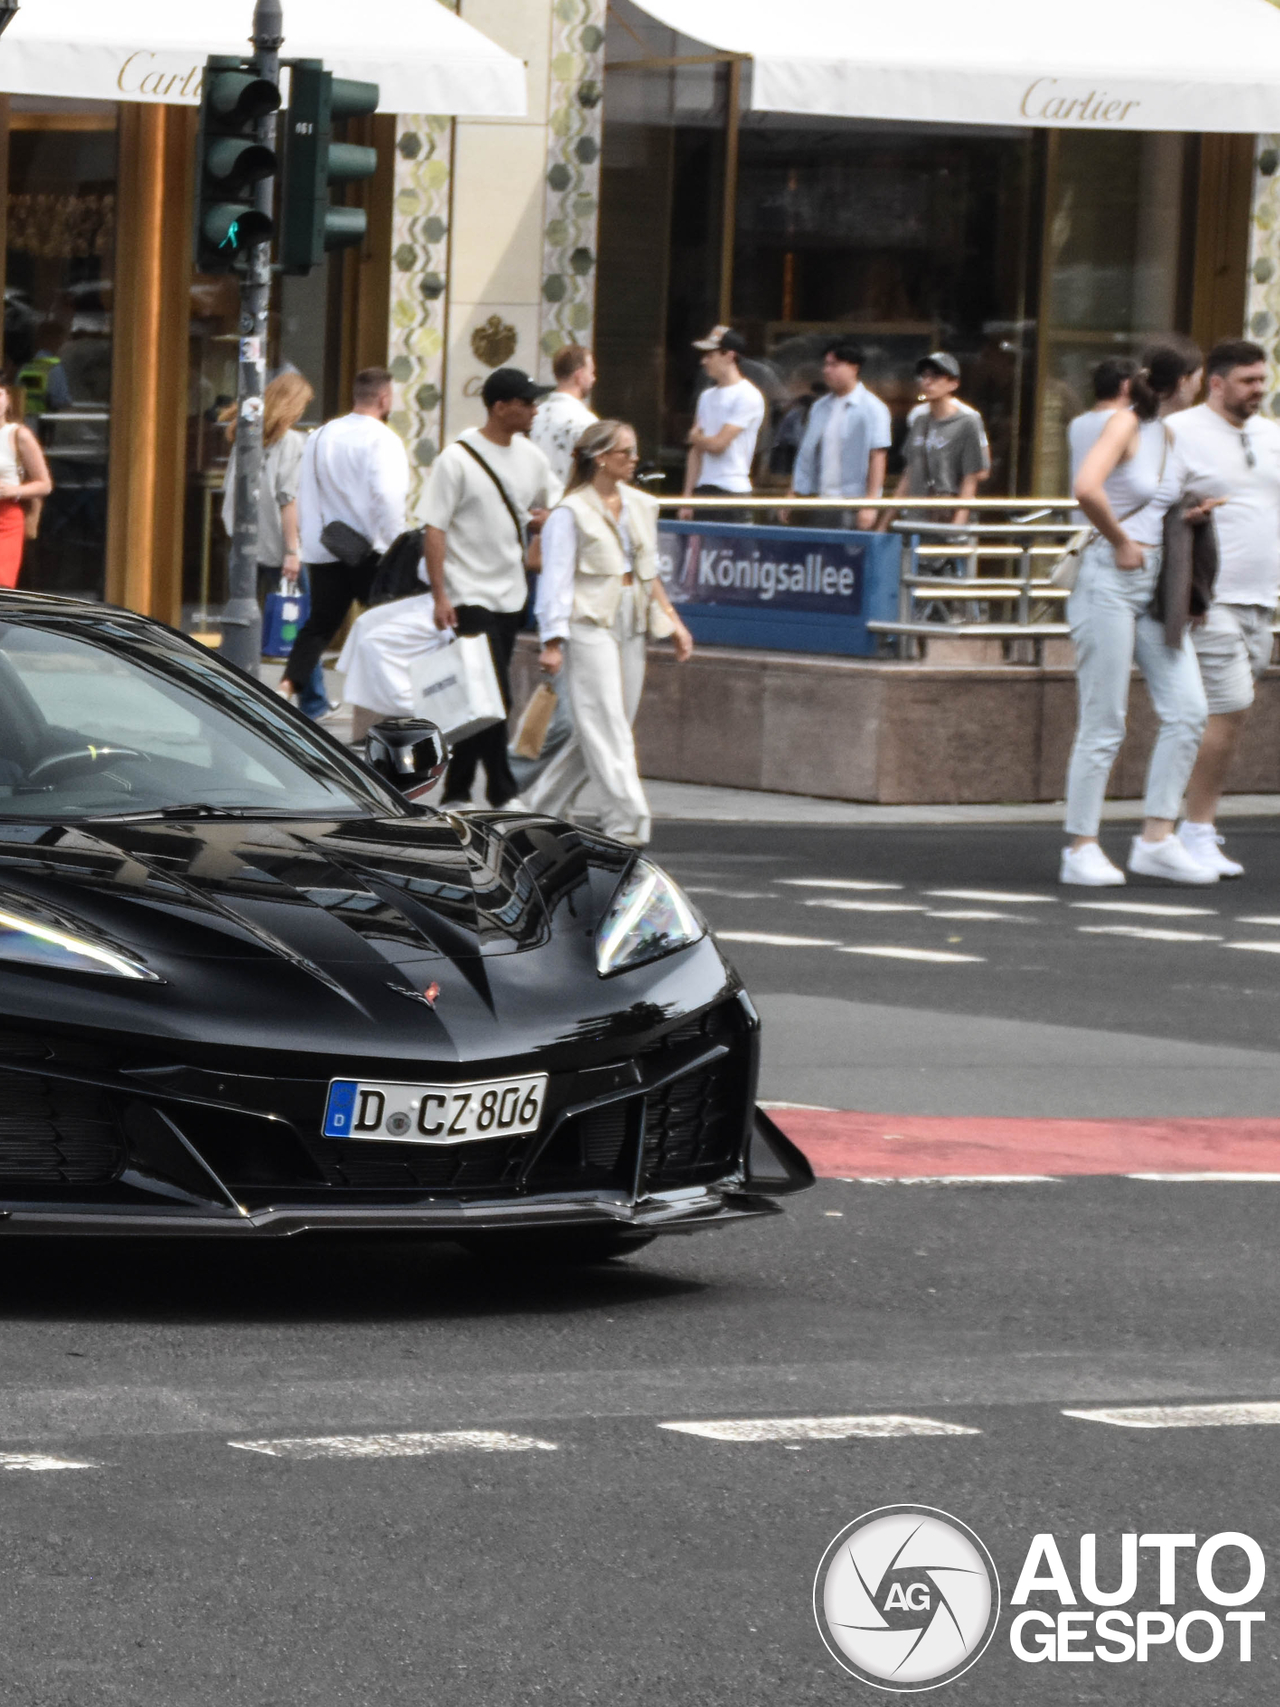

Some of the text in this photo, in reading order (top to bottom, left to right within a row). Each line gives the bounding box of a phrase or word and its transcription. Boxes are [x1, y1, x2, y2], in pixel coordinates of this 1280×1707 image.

[117, 49, 202, 97] Carti
[1020, 77, 1140, 121] Cartier
[698, 549, 855, 600] Königsallee
[333, 1114, 345, 1127] D
[354, 1088, 386, 1132] D
